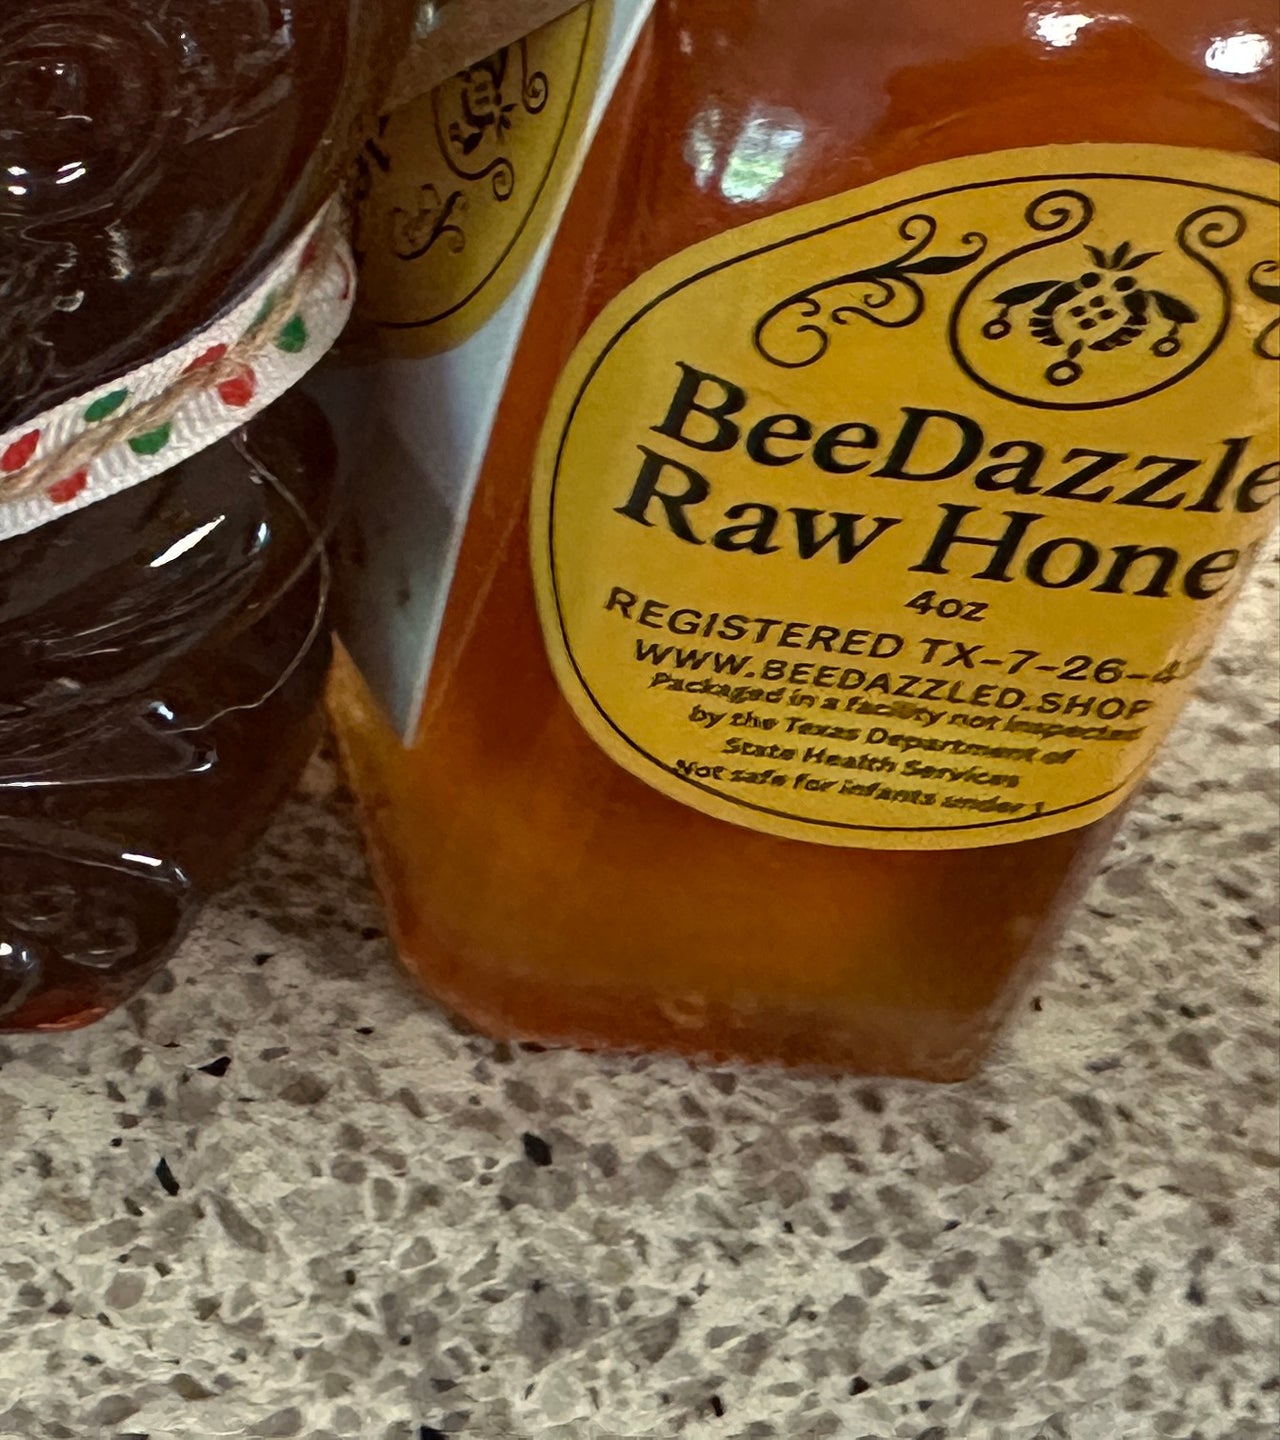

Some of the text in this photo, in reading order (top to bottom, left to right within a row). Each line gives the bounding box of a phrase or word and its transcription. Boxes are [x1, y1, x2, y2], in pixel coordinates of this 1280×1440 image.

[612, 445, 903, 565] Raw
[604, 586, 905, 658] REGISTERED
[904, 590, 989, 622] 4oz
[647, 671, 786, 704] Packaged
[689, 704, 728, 729] by
[730, 710, 779, 731] the
